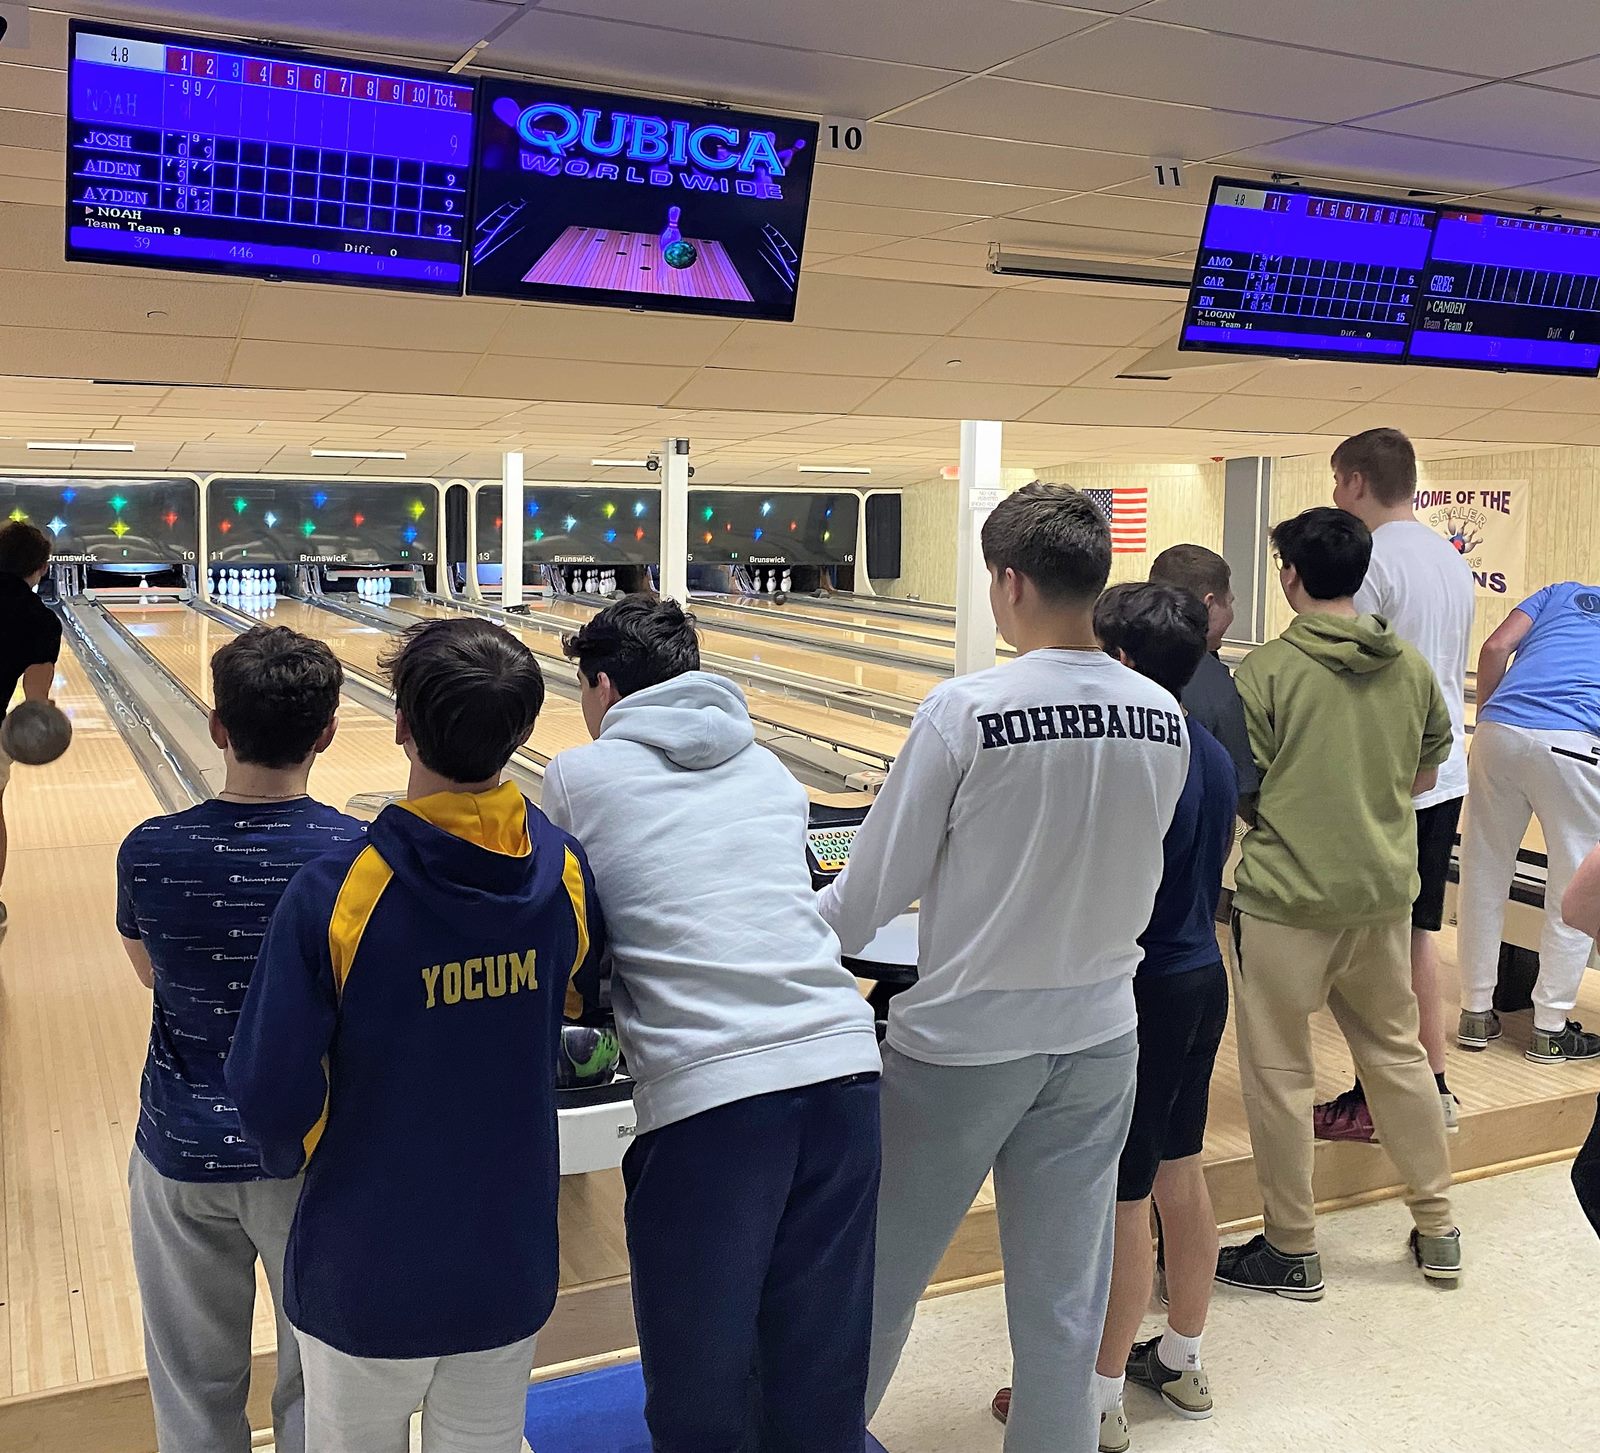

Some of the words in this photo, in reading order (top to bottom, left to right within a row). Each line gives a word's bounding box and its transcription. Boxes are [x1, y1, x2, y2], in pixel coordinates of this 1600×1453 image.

[111, 46, 128, 62] 4.8
[180, 55, 187, 71] 1
[206, 58, 213, 75] 2
[232, 62, 239, 78] 3
[260, 66, 266, 82] 4
[287, 70, 294, 85] 5
[314, 74, 321, 89] 6
[340, 78, 347, 92] 7
[367, 81, 374, 96] 8
[393, 85, 400, 99] 9
[412, 88, 425, 103] 10
[434, 88, 457, 108] Tot.
[86, 88, 137, 116] NOAH
[517, 103, 786, 176] QUBICA
[828, 125, 863, 150] 10
[84, 132, 132, 148] JOSH
[447, 174, 455, 186] 9
[521, 153, 783, 199] WORLDWIDE
[1154, 165, 1181, 186] 11
[83, 159, 142, 177] AIDEN
[445, 200, 454, 212] 9
[83, 186, 149, 205] AYDEN
[194, 199, 210, 212] 12
[436, 224, 452, 237] 12
[98, 206, 142, 220] NOAH
[1330, 204, 1336, 216] 5
[1360, 208, 1366, 220] 7
[85, 218, 120, 230] Team
[128, 222, 165, 235] Team
[173, 227, 181, 236] 9
[344, 243, 374, 255] Diff.
[134, 236, 150, 249] 39
[229, 246, 254, 259] 446
[1208, 256, 1233, 267] AMO
[1431, 275, 1455, 293] GREG
[1199, 295, 1214, 306] EN
[1396, 312, 1406, 322] 15
[1205, 310, 1236, 319] LOGAN
[1432, 300, 1466, 315] CAMDEN
[1220, 320, 1241, 329] Team
[1423, 317, 1441, 329] Team
[1443, 318, 1462, 331] Team
[1464, 321, 1474, 333] 12
[1546, 327, 1563, 339] Diff.
[1413, 491, 1451, 511] HOME
[1456, 491, 1475, 504] OF
[1480, 491, 1511, 515] THE
[1429, 507, 1487, 529] SHALER
[182, 551, 196, 560] 10
[211, 552, 224, 560] 11
[300, 554, 347, 563] Brunswick
[422, 553, 434, 561] 12
[478, 552, 490, 561] 13
[554, 555, 595, 563] Brunswick
[977, 704, 1181, 749] ROHRBAUGH
[234, 821, 291, 830] Champion
[213, 844, 268, 854] Champion
[229, 875, 289, 884] Champion
[212, 900, 266, 909] Champion
[421, 949, 539, 1009] YOCUM
[205, 1161, 259, 1170] Champion
